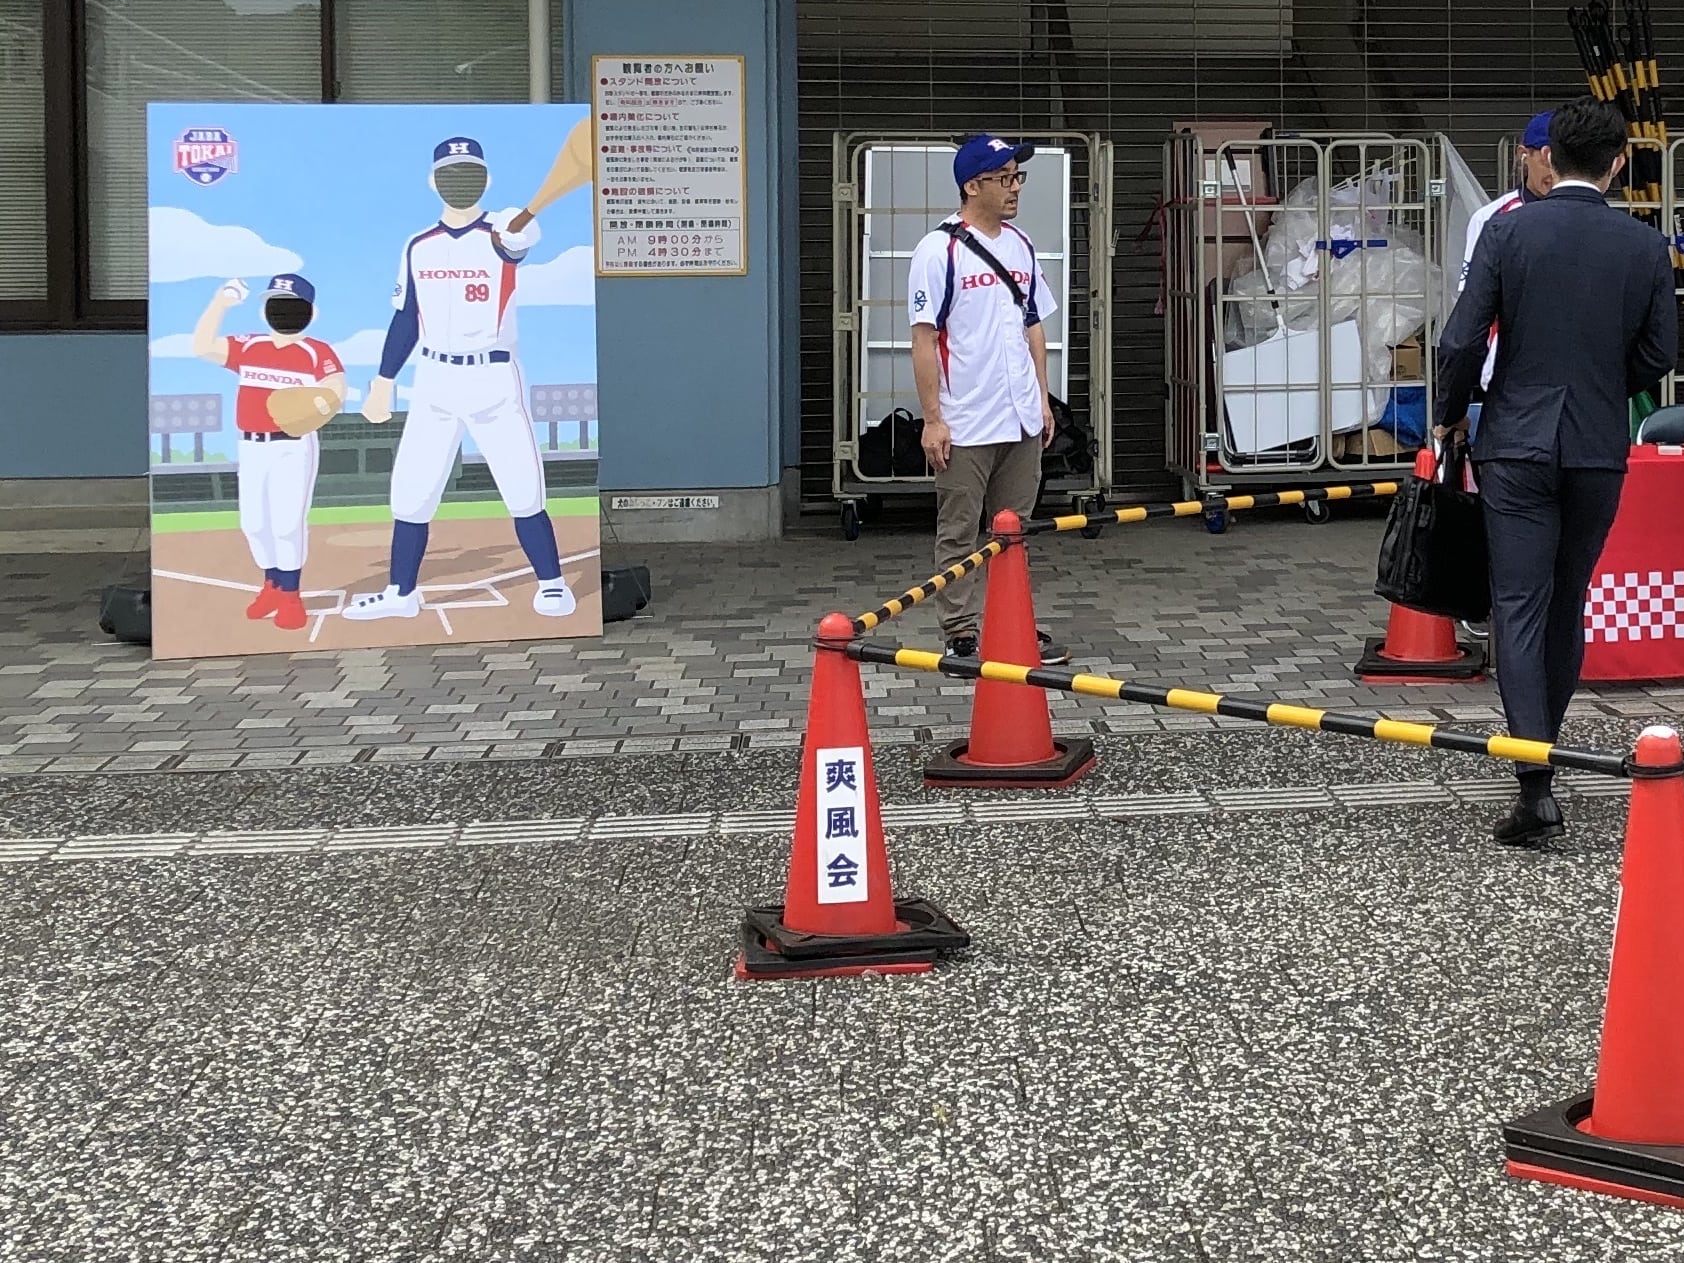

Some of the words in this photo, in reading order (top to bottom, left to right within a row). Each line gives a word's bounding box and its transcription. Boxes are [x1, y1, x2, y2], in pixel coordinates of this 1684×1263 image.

[178, 144, 233, 167] TOKAI
[447, 142, 470, 155] H
[617, 235, 637, 245] AM
[617, 247, 637, 257] PM
[418, 269, 491, 280] HONDA
[272, 278, 295, 292] H
[465, 283, 490, 303] 89
[244, 370, 304, 386] HONDA
[824, 758, 860, 888] 爽風会
